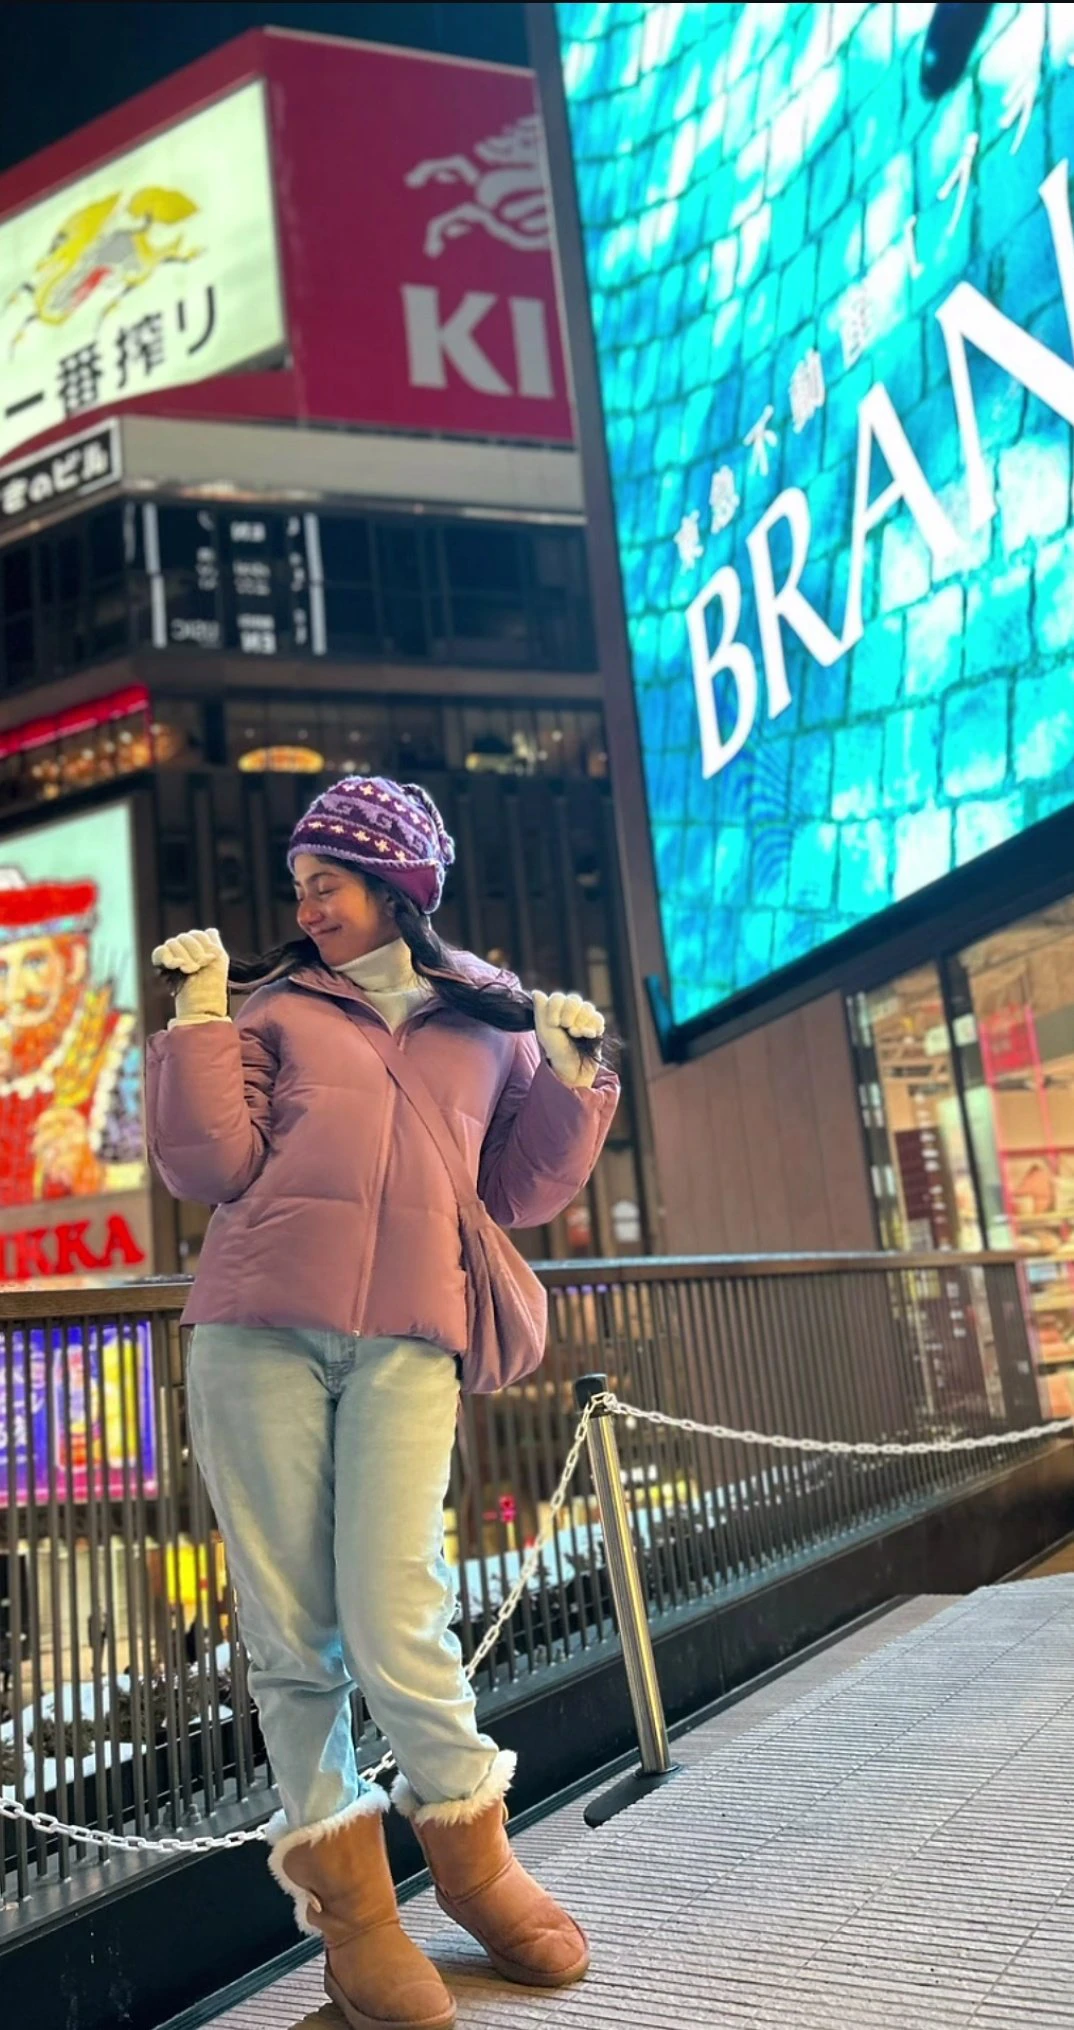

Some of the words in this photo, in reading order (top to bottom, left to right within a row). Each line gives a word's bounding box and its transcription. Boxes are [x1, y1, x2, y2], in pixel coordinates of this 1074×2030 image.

[4, 284, 215, 419] 一番搾り
[402, 285, 554, 399] KI
[685, 157, 1074, 780] BRAN
